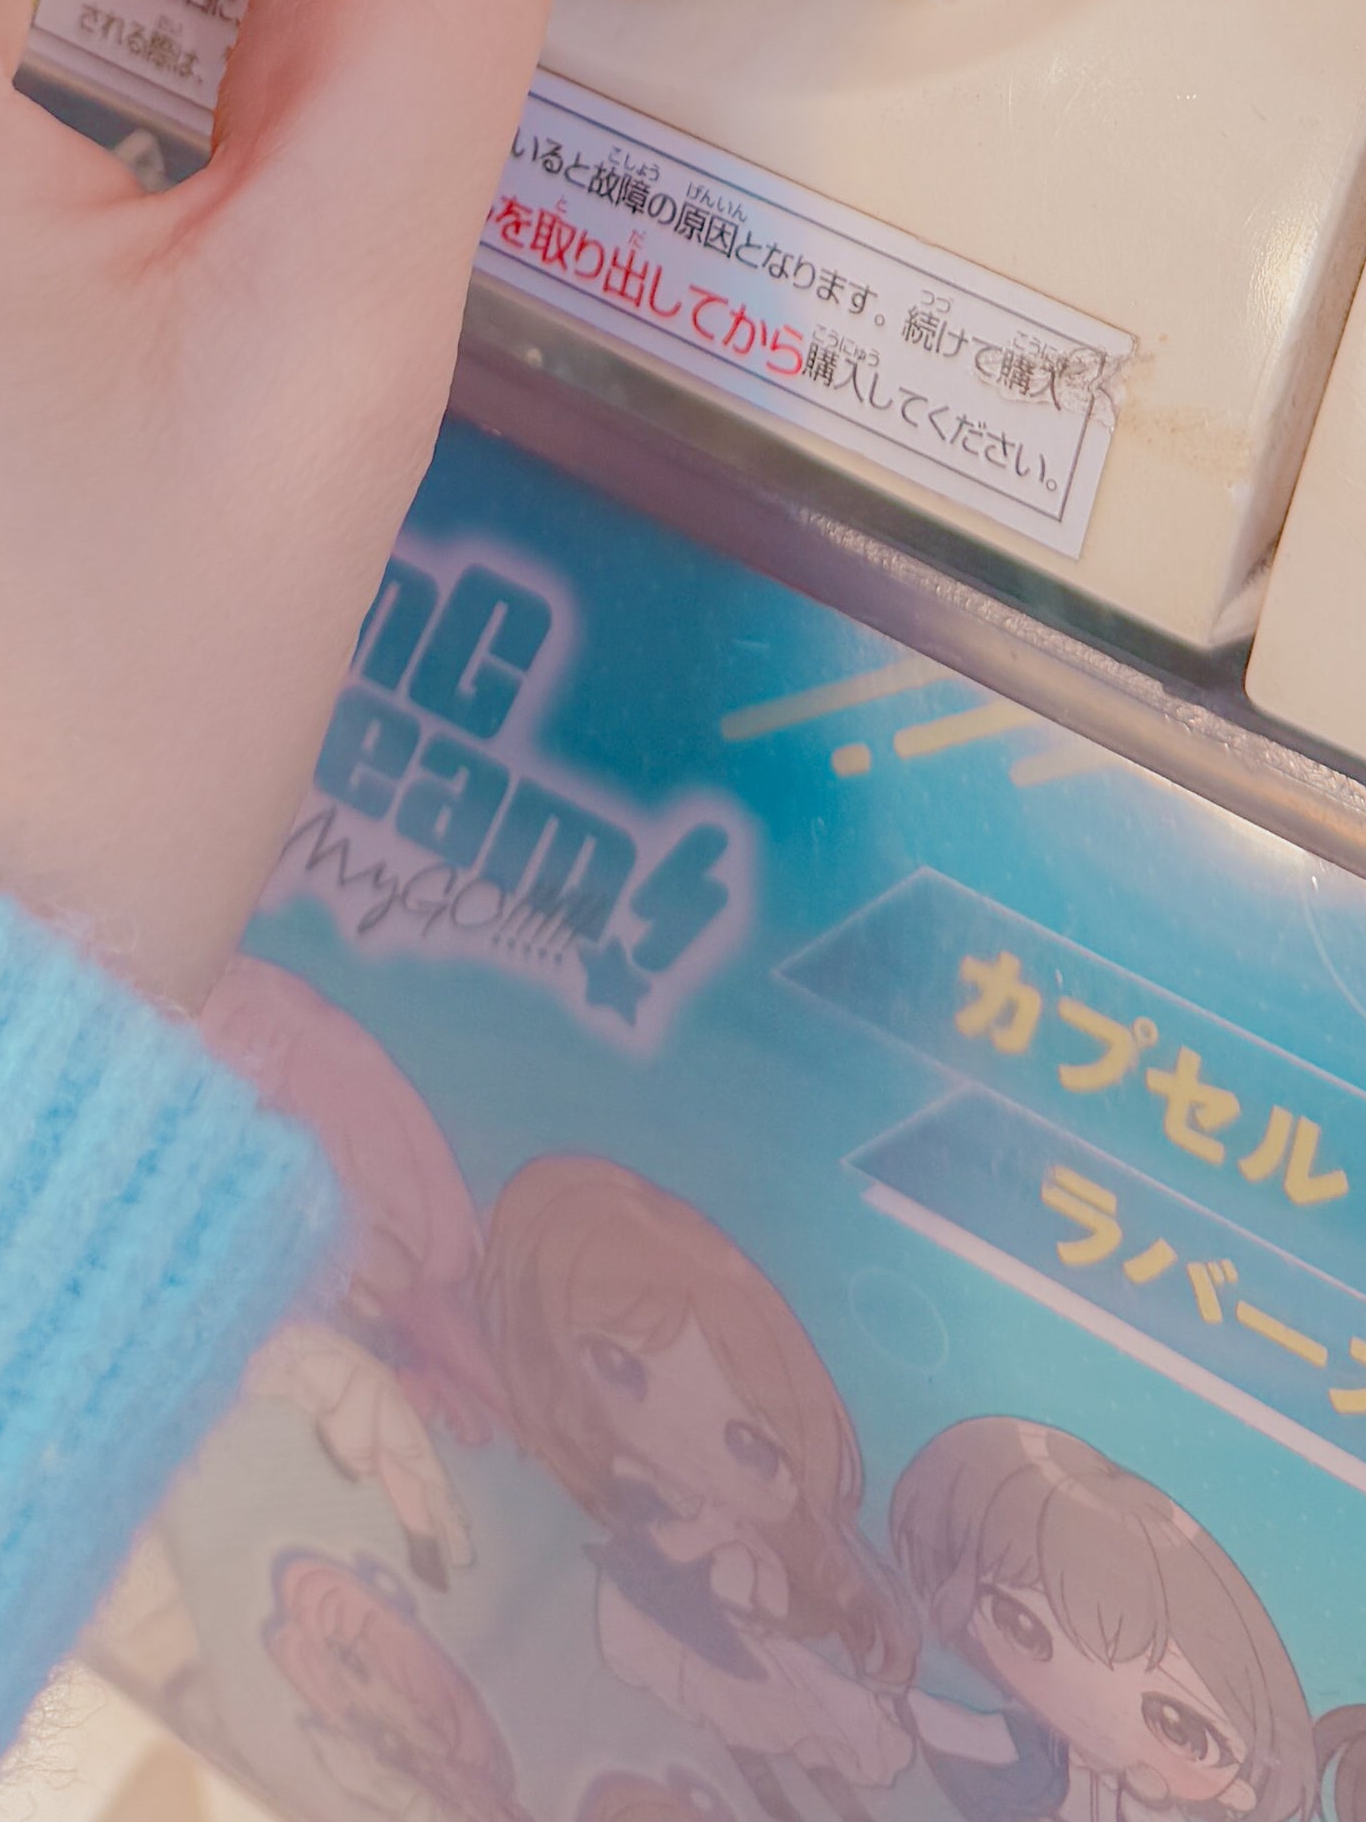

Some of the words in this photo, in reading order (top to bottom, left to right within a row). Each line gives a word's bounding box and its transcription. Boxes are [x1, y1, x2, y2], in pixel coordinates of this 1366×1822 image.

[486, 194, 1059, 492] を取り出してから購入してください。
[954, 952, 1349, 1208] カプセル
